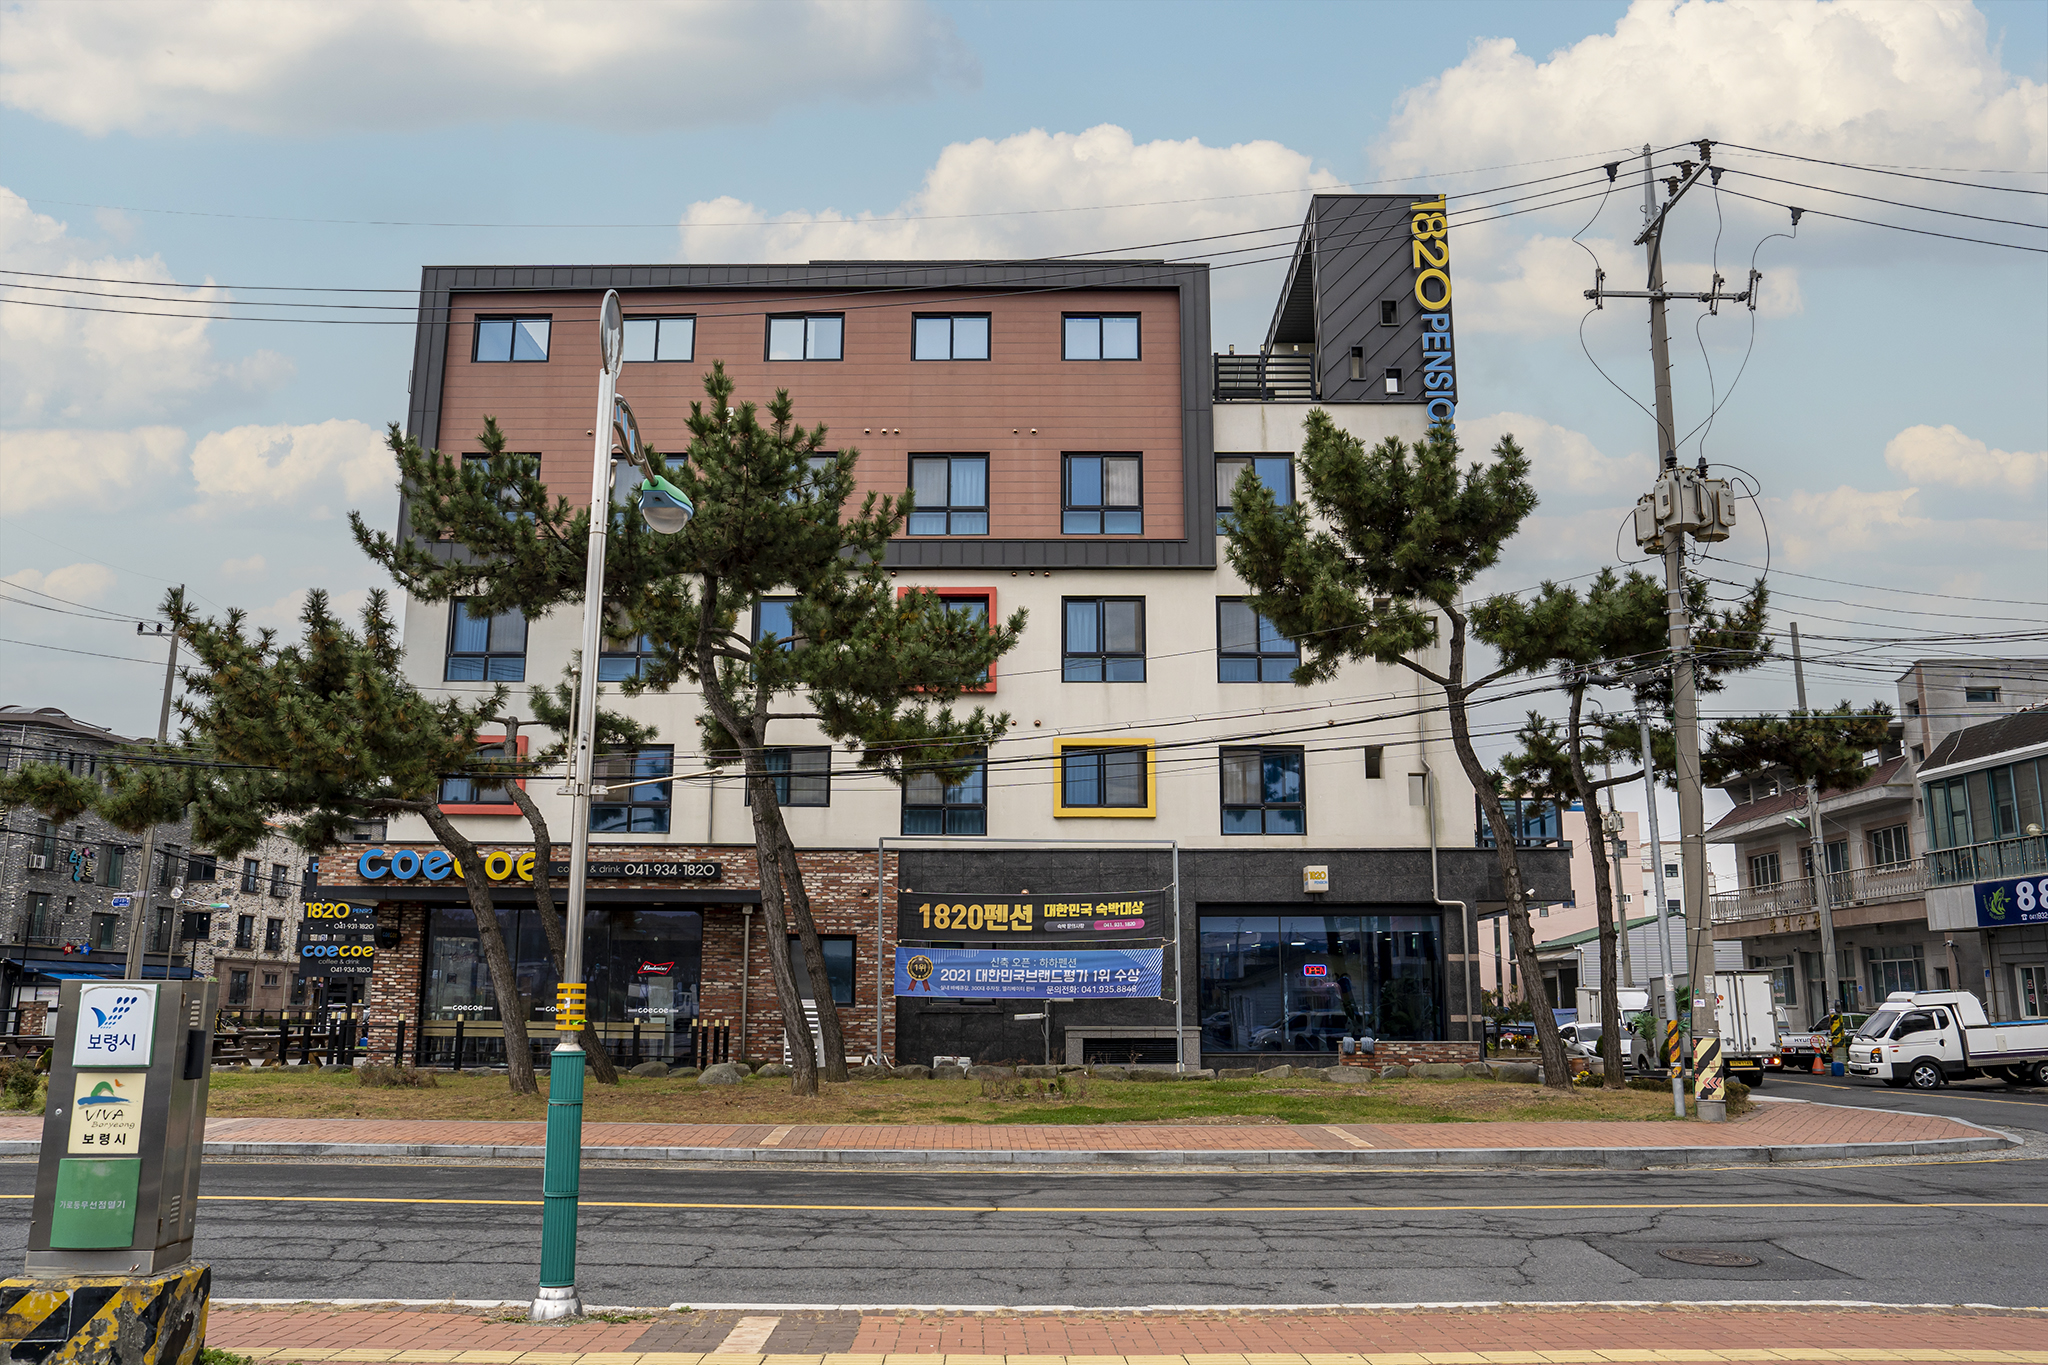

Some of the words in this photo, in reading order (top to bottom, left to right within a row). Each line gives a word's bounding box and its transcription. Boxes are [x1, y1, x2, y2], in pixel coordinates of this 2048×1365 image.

[1411, 194, 1451, 311] 1820
[590, 865, 597, 873] &
[599, 864, 621, 873] drink
[305, 903, 351, 919] 1820
[1044, 903, 1093, 917] 대한민국
[1095, 901, 1145, 916] 숙박대상
[919, 903, 1033, 931] 1820펜션
[302, 945, 375, 958] coecoe
[914, 963, 927, 972] 1위
[990, 957, 1010, 968] 신축
[1012, 957, 1030, 968] 오픈
[1039, 957, 1077, 968] 하하펜션
[940, 968, 971, 982] 2021
[975, 968, 1089, 983] 대한민국브랜드평가
[1093, 968, 1111, 982] 1위
[1114, 968, 1141, 982] 수상
[1305, 966, 1326, 975] OPEN
[1046, 986, 1080, 994] 문의전화:
[87, 1034, 136, 1052] 보령시
[85, 1109, 124, 1121] VIVA
[91, 1121, 135, 1129] Boryeong
